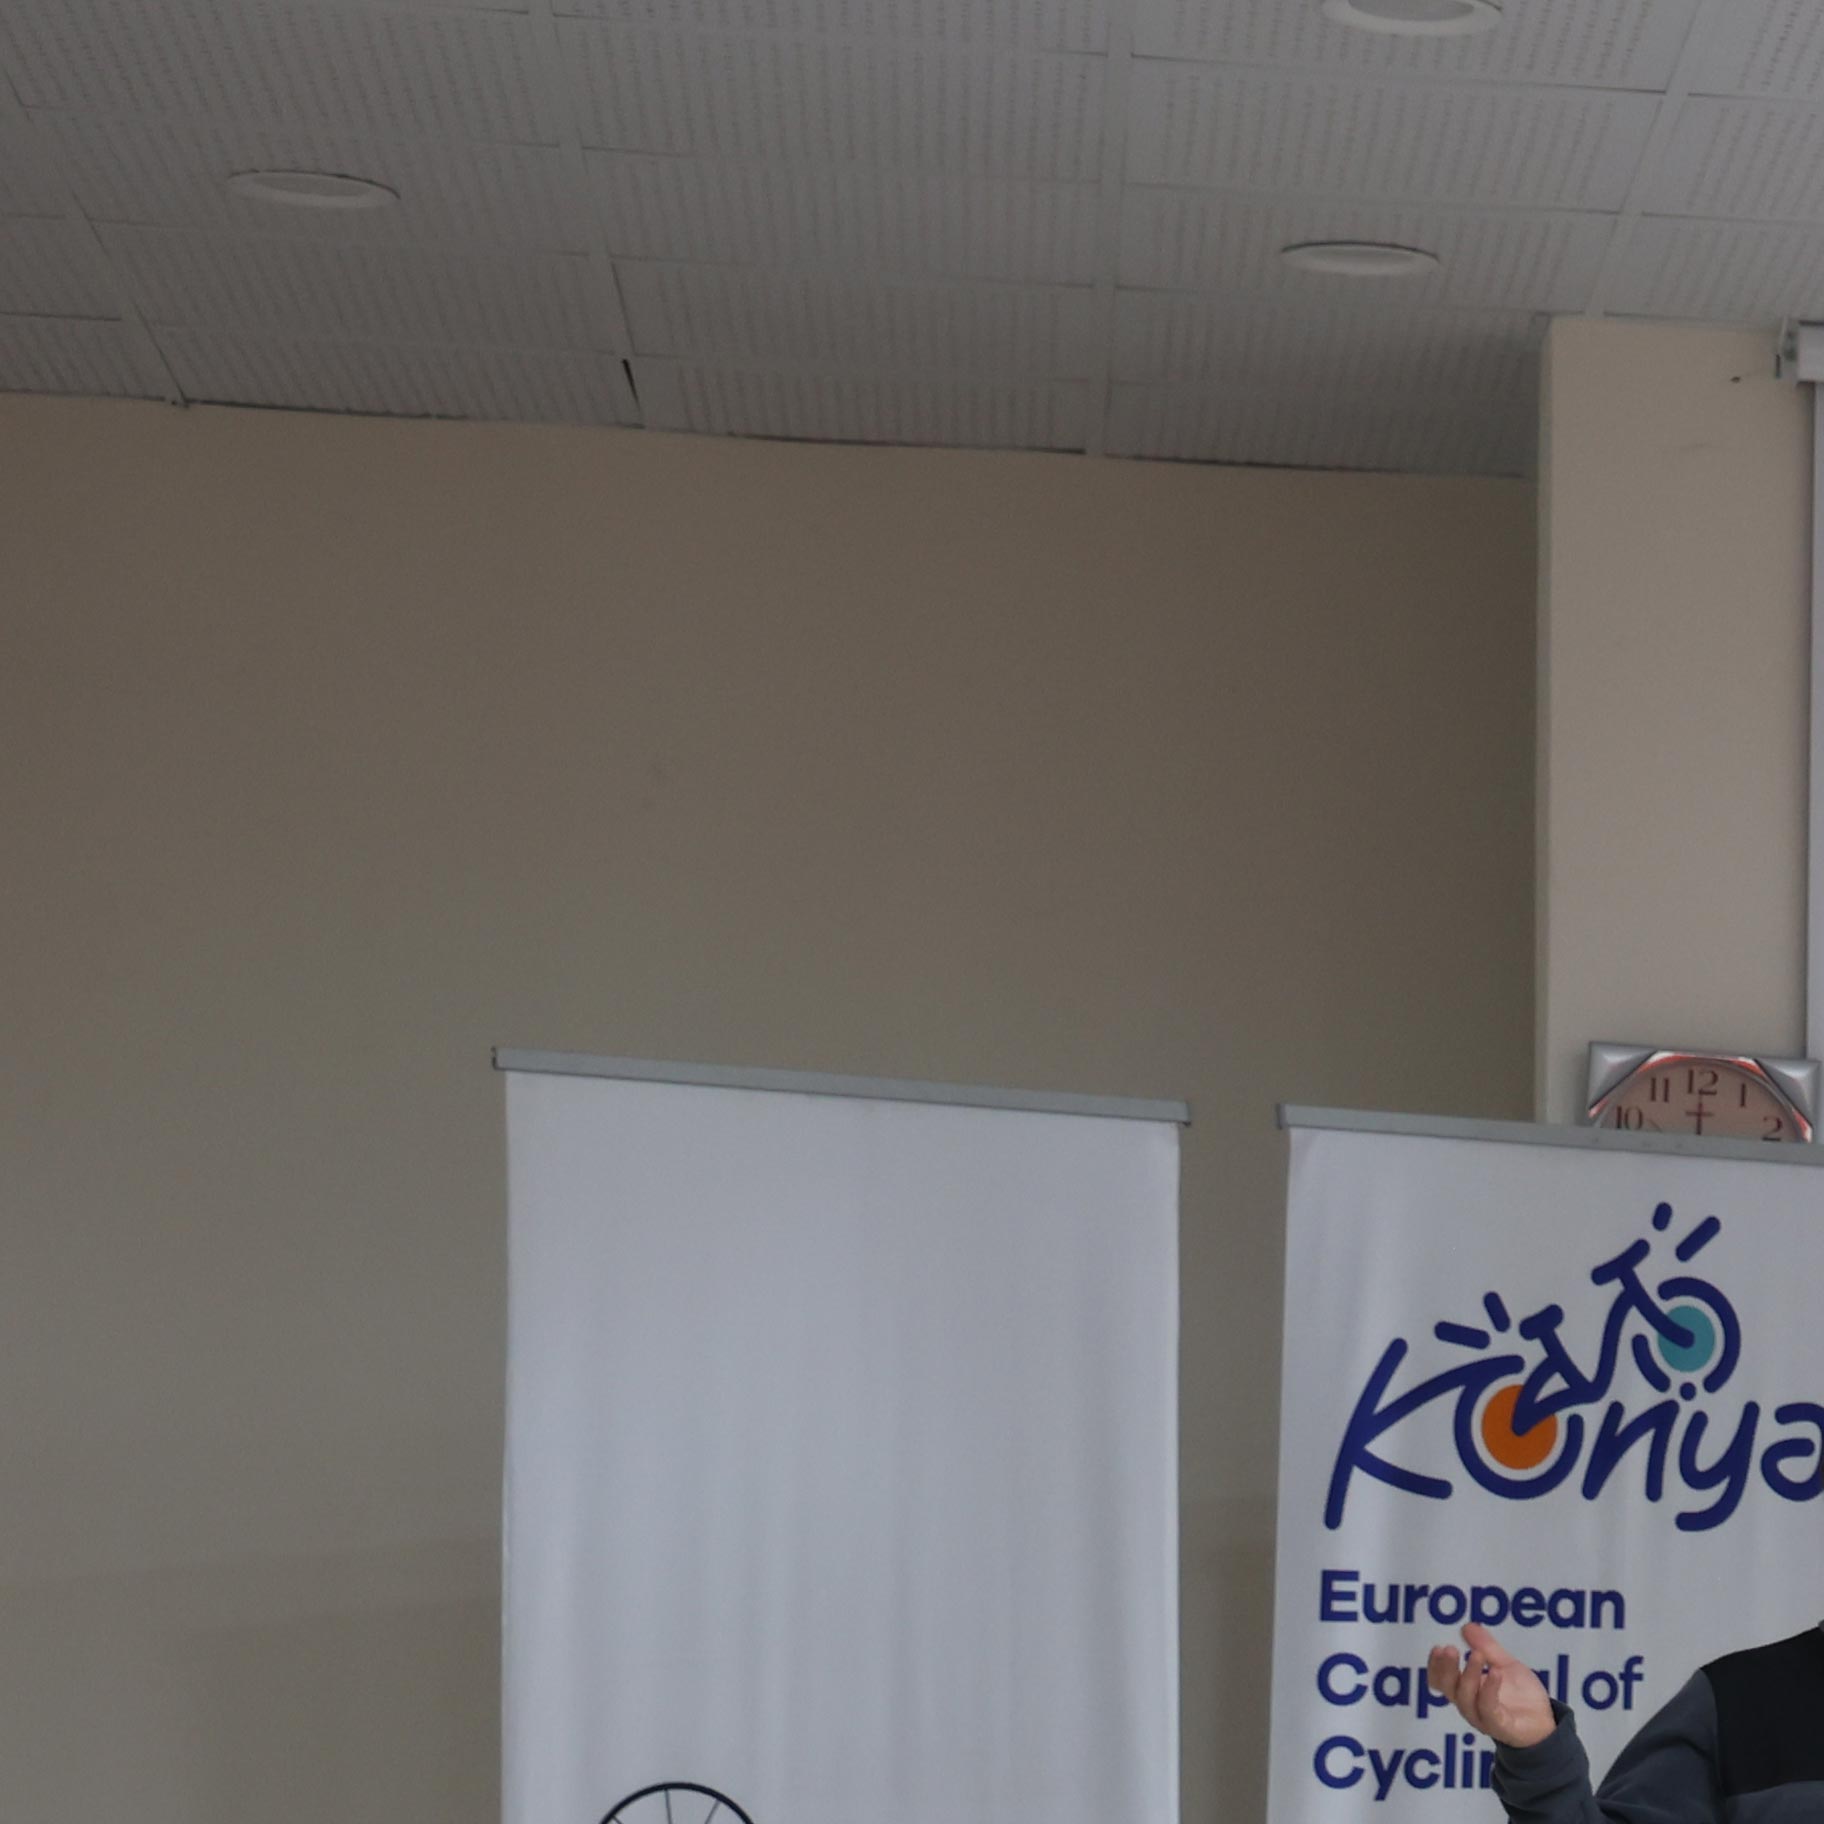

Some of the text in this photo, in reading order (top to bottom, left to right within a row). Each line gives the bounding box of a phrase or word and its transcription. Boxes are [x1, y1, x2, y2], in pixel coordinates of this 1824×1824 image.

[1651, 1077, 1670, 1103] 11
[1687, 1069, 1719, 1095] 12
[1739, 1082, 1747, 1107] 1
[1616, 1105, 1643, 1130] 10
[1762, 1116, 1783, 1141] 2
[1320, 1569, 1626, 1630] European
[1582, 1655, 1645, 1711] of
[1313, 1733, 1496, 1801] Cycli
